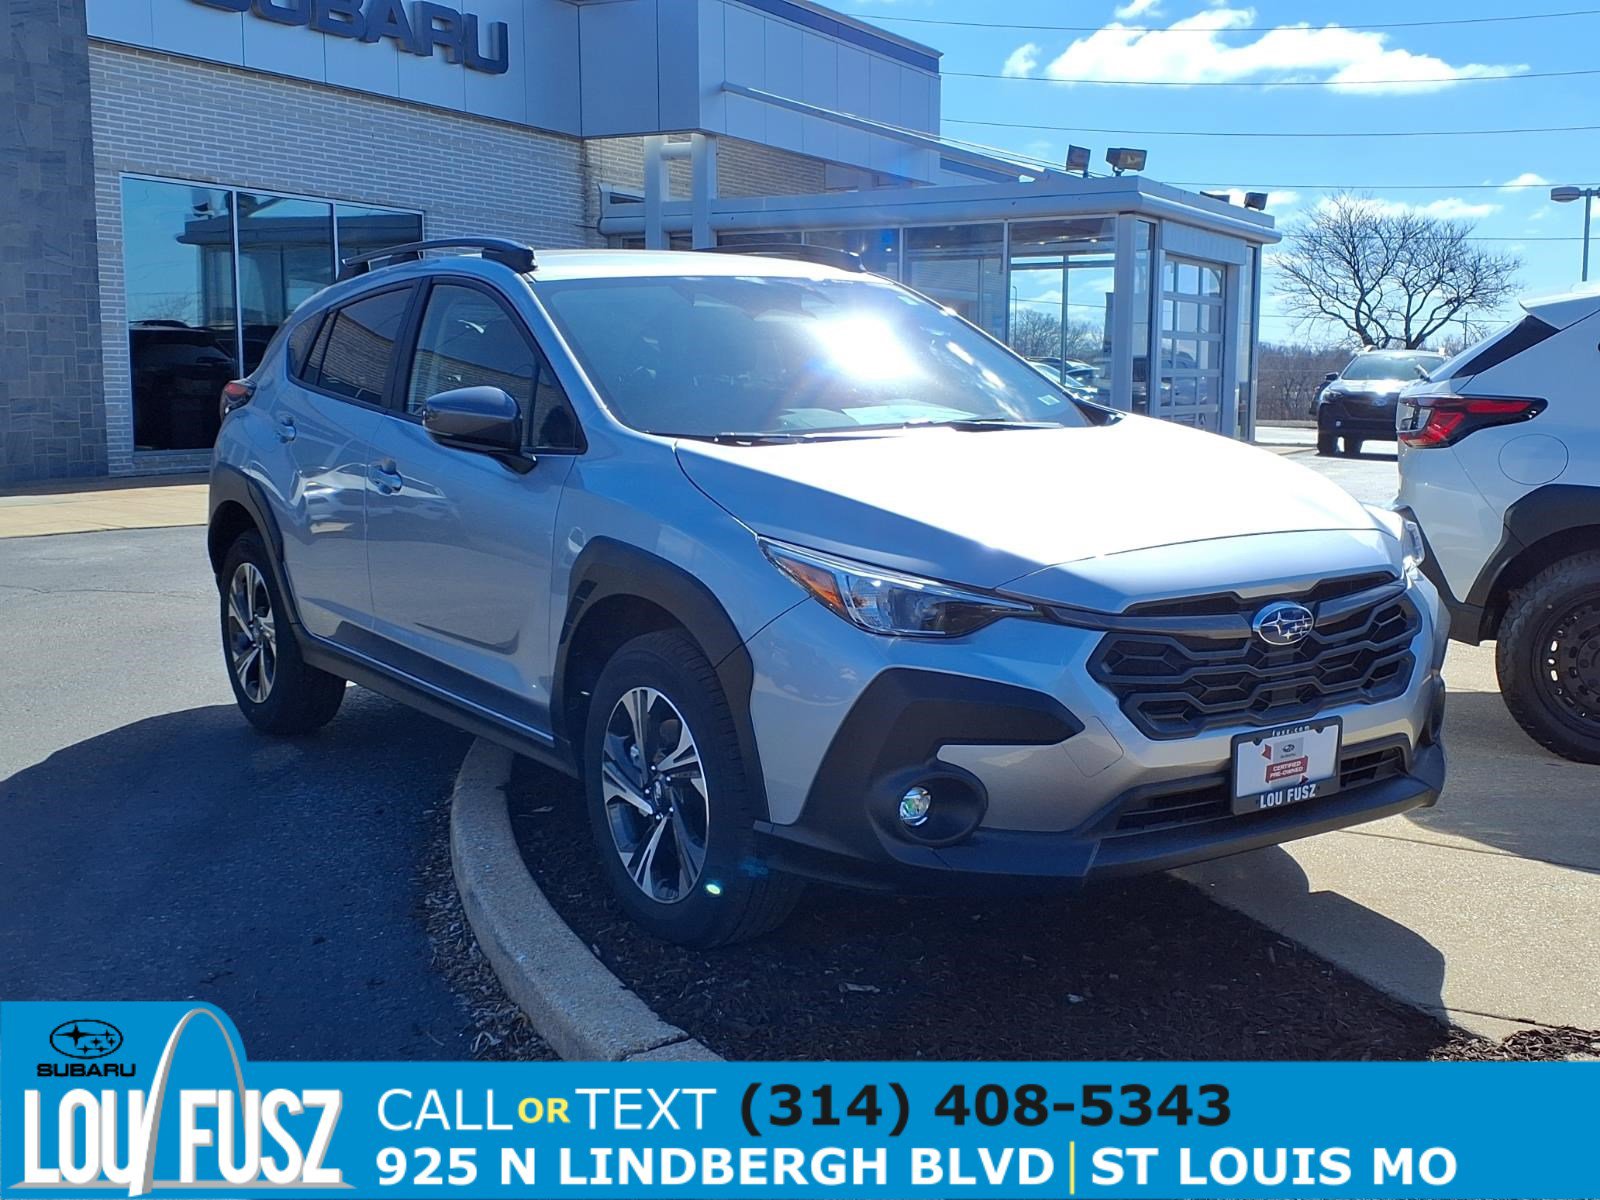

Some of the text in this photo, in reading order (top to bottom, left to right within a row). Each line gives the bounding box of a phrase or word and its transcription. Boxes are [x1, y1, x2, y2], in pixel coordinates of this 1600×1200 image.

[191, 0, 509, 75] BARU
[1269, 766, 1304, 779] PRE-OWNED
[1273, 760, 1302, 772] CERTIFIED
[1260, 784, 1316, 809] LOU FUSZ
